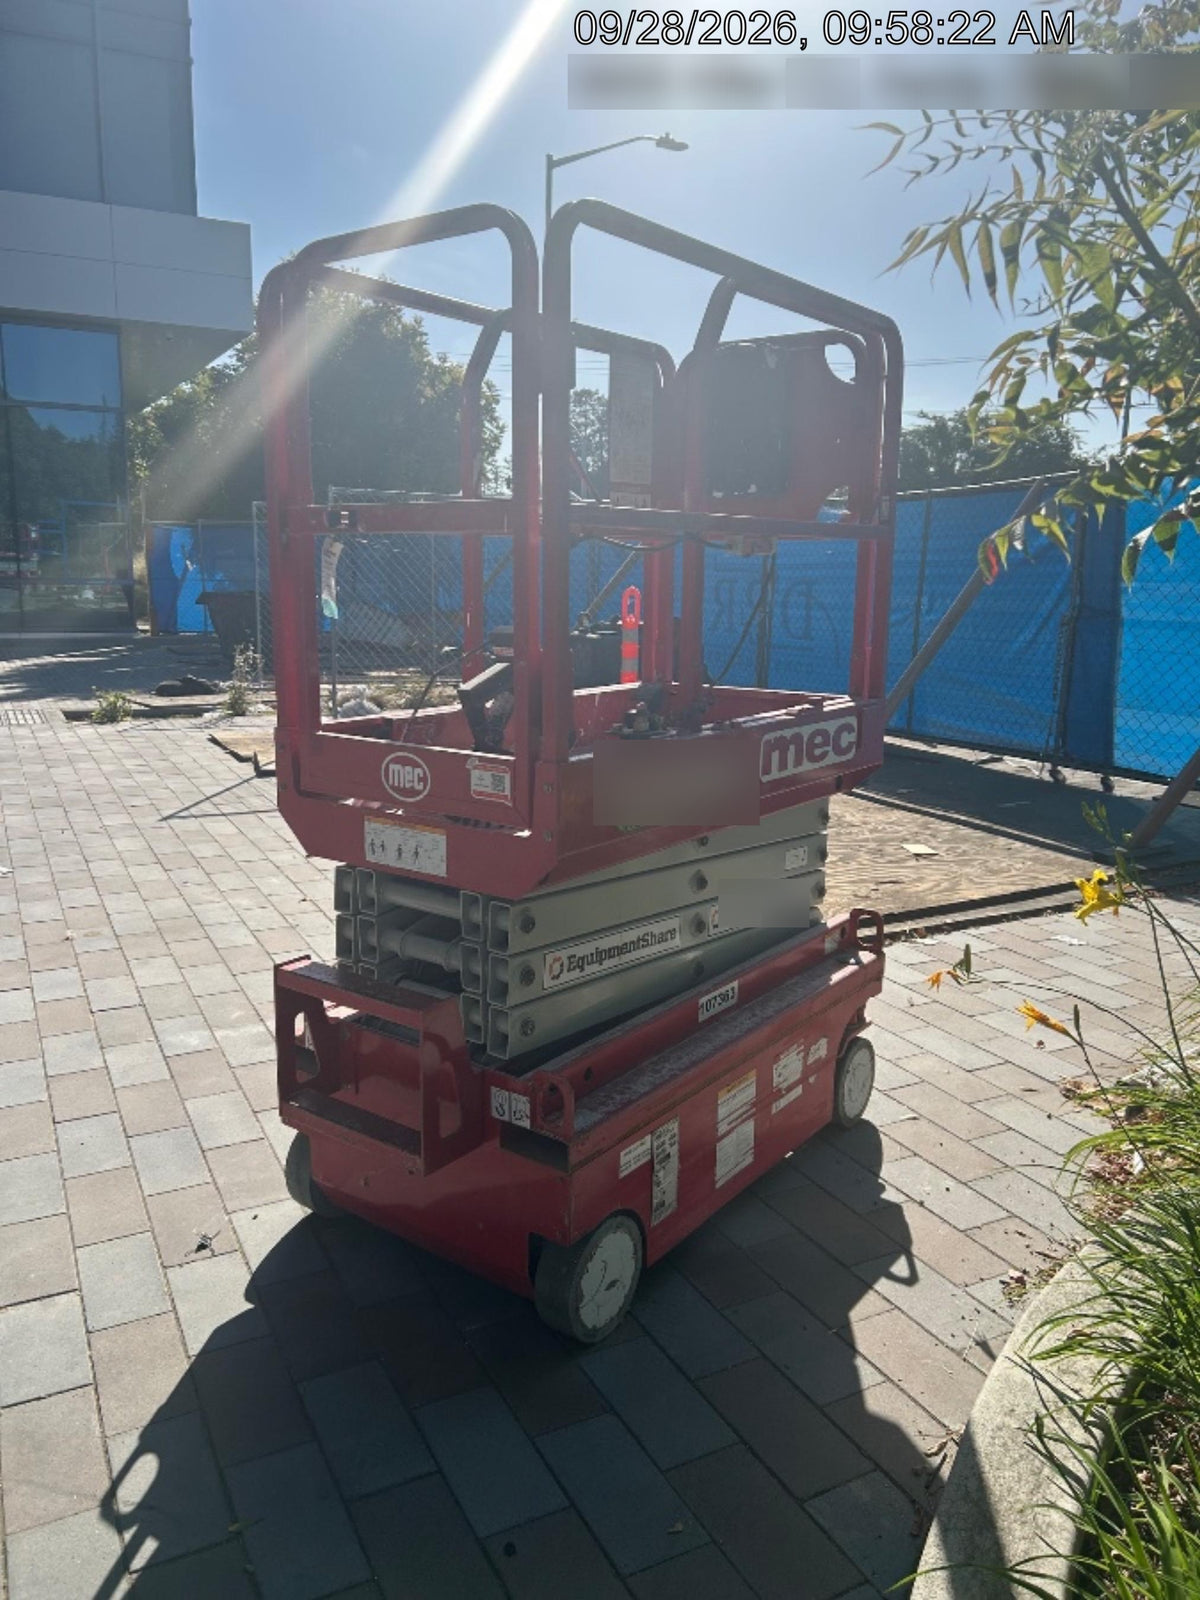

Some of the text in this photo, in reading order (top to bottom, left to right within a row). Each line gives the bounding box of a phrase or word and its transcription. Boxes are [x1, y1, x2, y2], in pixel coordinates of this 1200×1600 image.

[762, 722, 857, 776] mec
[388, 763, 425, 791] mec
[566, 927, 677, 973] EquipmentShare
